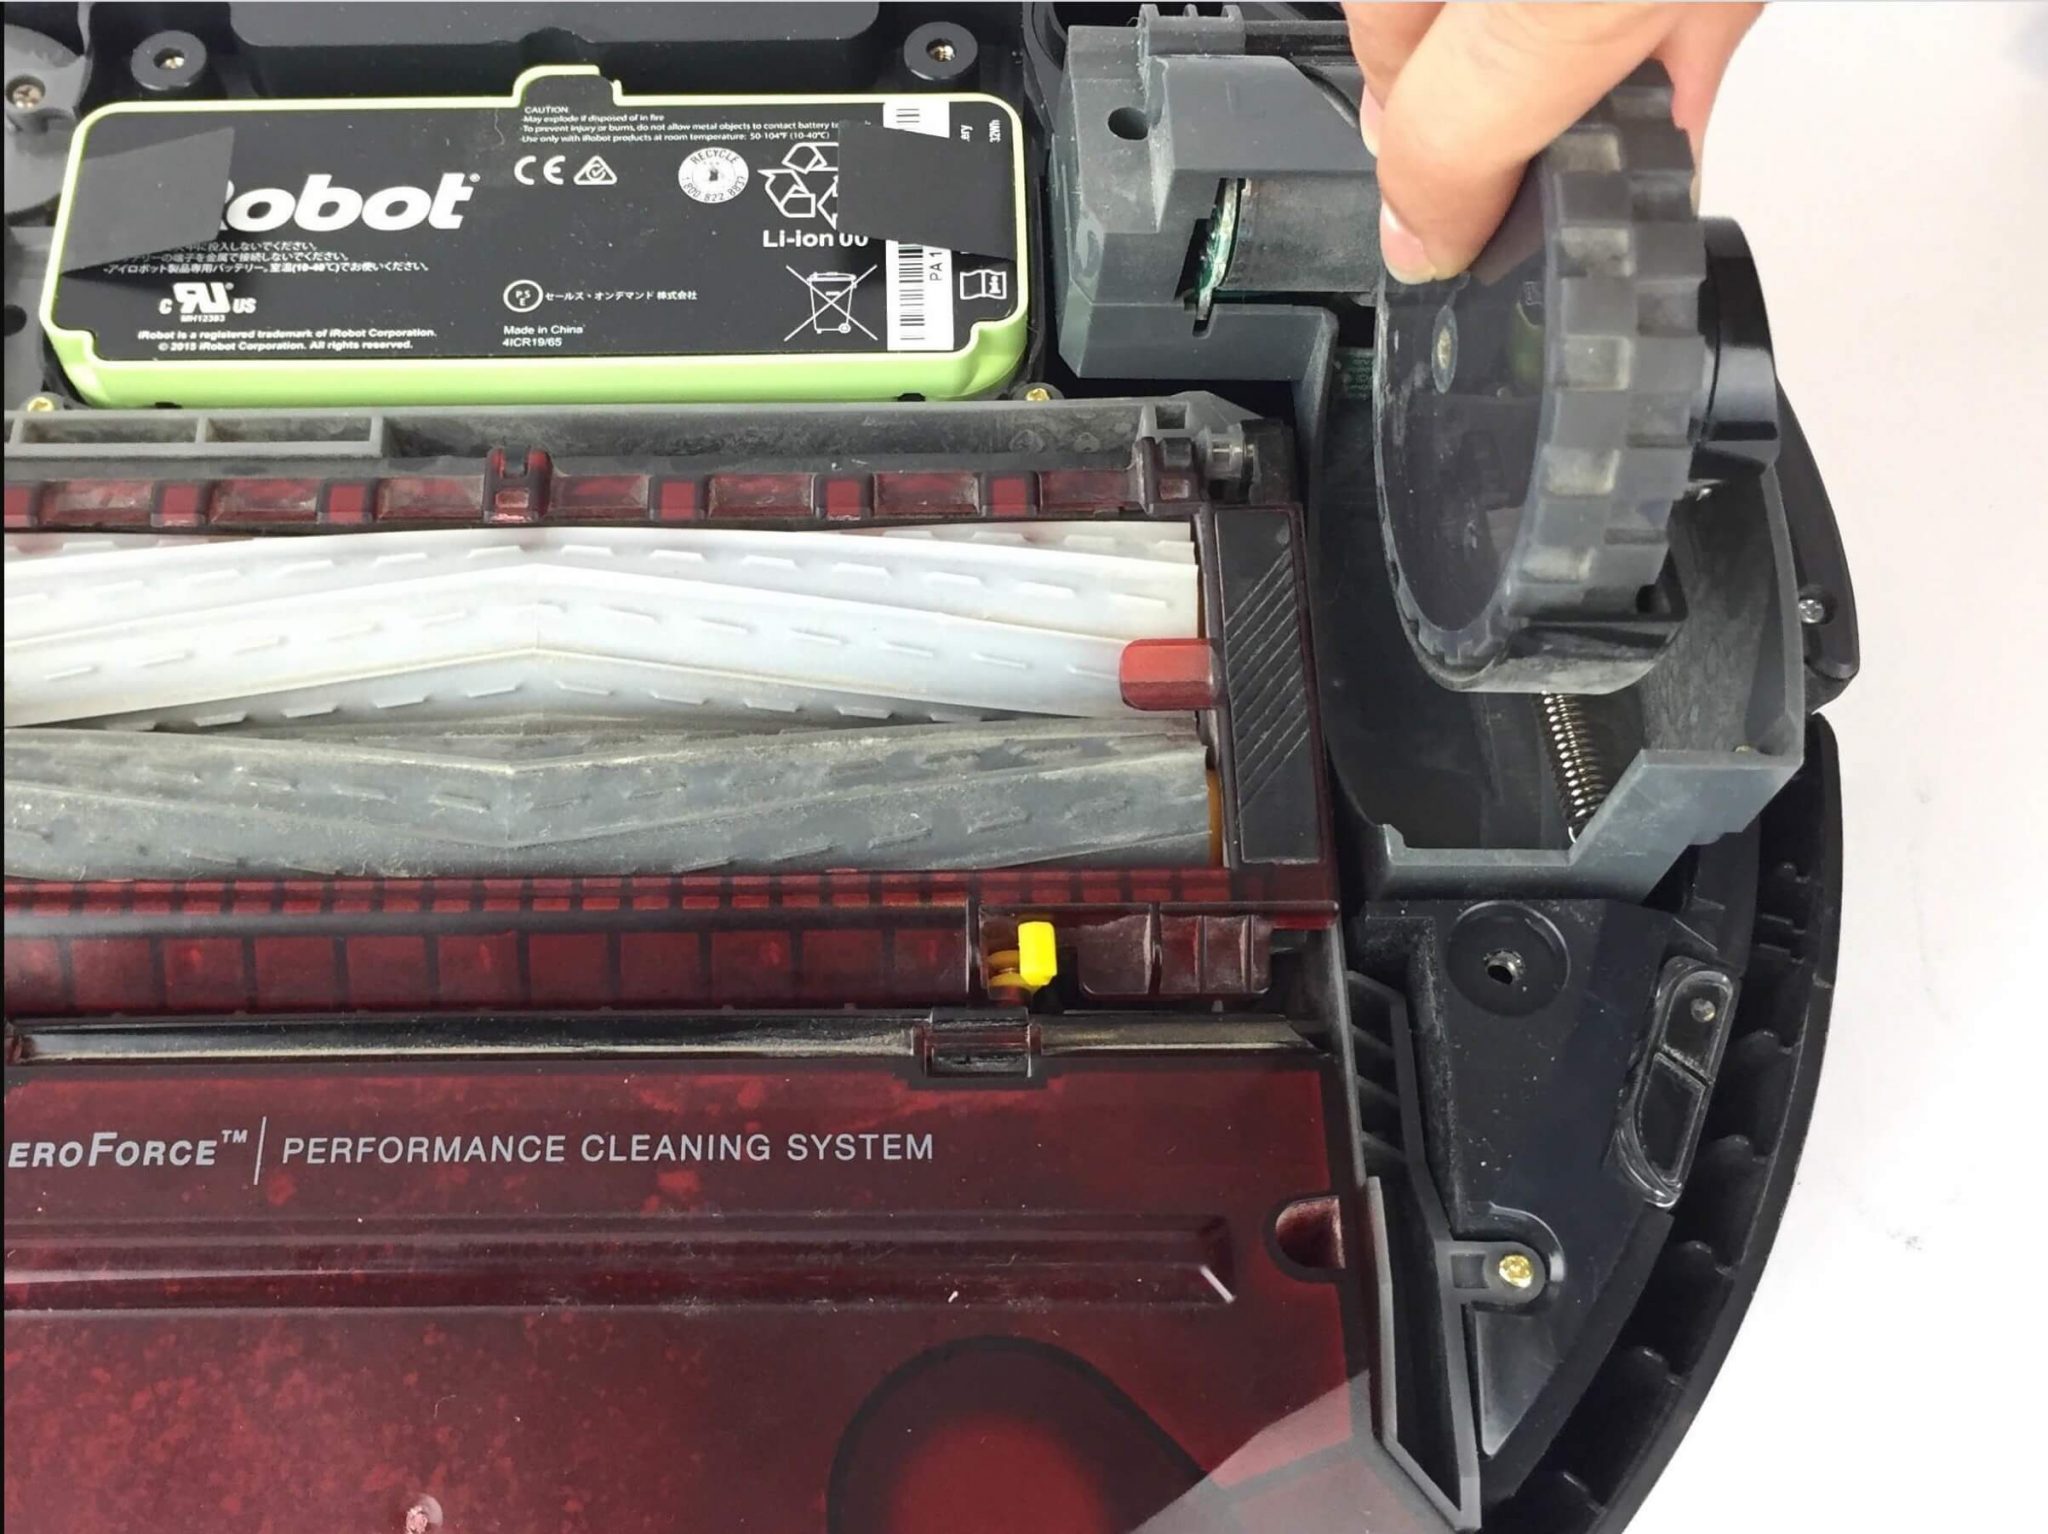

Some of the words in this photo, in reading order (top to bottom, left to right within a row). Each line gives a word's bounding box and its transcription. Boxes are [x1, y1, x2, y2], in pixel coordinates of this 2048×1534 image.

[524, 106, 569, 114] CAUTION
[543, 115, 579, 124] explode
[588, 114, 627, 124] disposed
[629, 114, 639, 122] of
[650, 113, 665, 121] fire
[535, 125, 569, 134] prevent
[570, 124, 596, 134] injury
[666, 123, 690, 131] allow
[719, 122, 750, 131] objects
[763, 122, 796, 130] contact
[798, 121, 829, 131] battery
[540, 135, 559, 144] only
[561, 134, 580, 142] with
[582, 134, 611, 142] iRobot
[612, 134, 652, 143] products
[690, 132, 747, 142] temperature:
[689, 149, 740, 165] RECYCLE
[763, 230, 834, 247] Li-ion
[929, 262, 943, 281] PA
[138, 330, 175, 340] iRobot
[177, 331, 187, 339] is
[199, 330, 255, 341] registered
[257, 329, 313, 339] trademark
[315, 329, 327, 338] of
[329, 328, 366, 338] iRobot
[368, 328, 437, 339] Corporation.
[503, 326, 535, 335] Made
[538, 325, 548, 335] in
[551, 325, 583, 335] China
[199, 342, 236, 351] iRobot
[238, 341, 307, 352] Corporation.
[309, 341, 325, 350] All
[327, 340, 360, 352] rights
[362, 340, 413, 350] reserved.
[502, 337, 563, 348] 4ICR19/65
[281, 1134, 566, 1164] PERFORMANCE
[580, 1133, 771, 1163] CLEANING
[786, 1133, 934, 1162] SYSTEM
